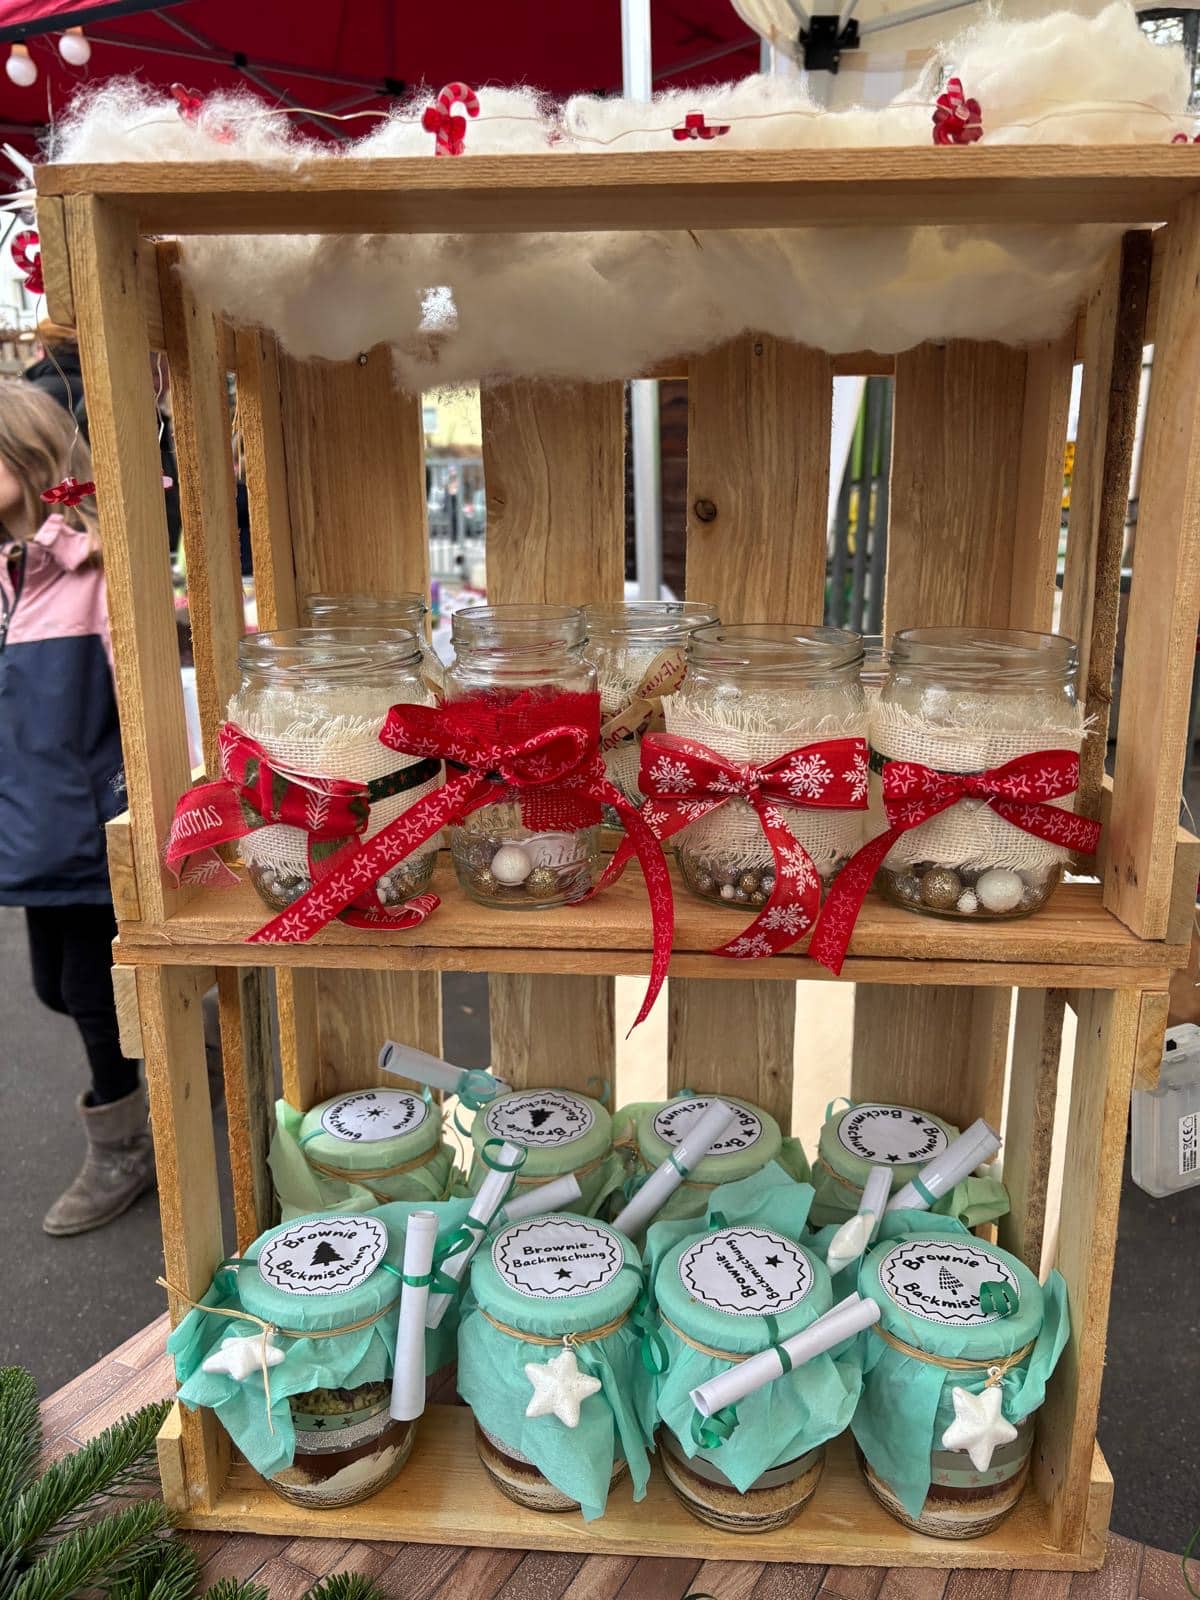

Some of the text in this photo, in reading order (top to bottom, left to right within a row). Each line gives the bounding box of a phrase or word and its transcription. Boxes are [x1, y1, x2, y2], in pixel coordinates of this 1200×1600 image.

[329, 1093, 377, 1140] Backmischung
[391, 1097, 417, 1131] Brownie
[505, 1099, 580, 1122] Backmischung
[506, 1123, 567, 1136] Brownie
[847, 1109, 903, 1158] Backmischung
[908, 1127, 941, 1159] Brownie
[282, 1229, 358, 1249] Brownie
[522, 1242, 594, 1256] Brownie-
[275, 1244, 371, 1281] Backmischung
[512, 1252, 606, 1268] Backmischung
[715, 1251, 758, 1298] Brownie-
[725, 1239, 781, 1300] Backmischung
[902, 1254, 980, 1271] Brownie
